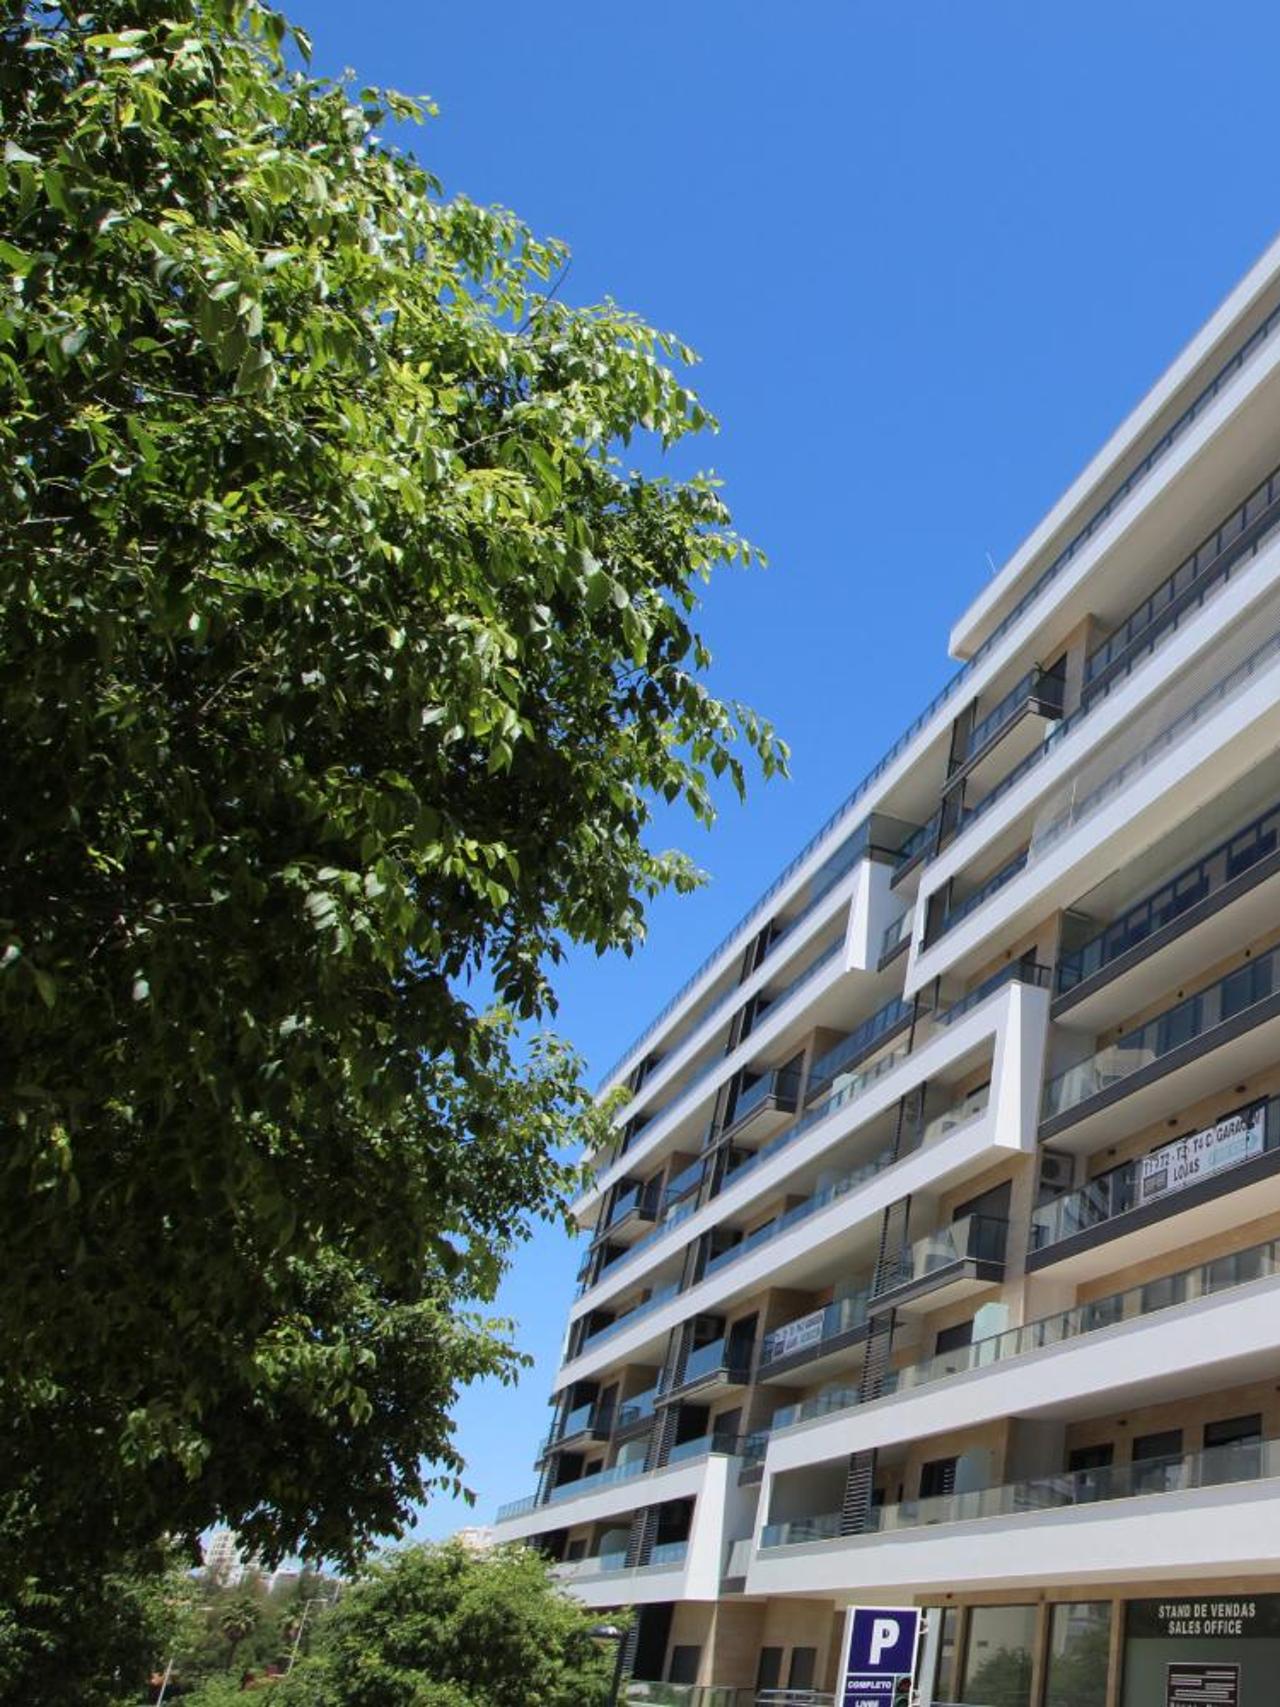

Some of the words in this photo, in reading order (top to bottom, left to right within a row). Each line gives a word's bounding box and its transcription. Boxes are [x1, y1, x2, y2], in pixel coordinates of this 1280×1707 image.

[1158, 1604, 1191, 1618] STAND
[1194, 1603, 1208, 1617] DE
[1211, 1602, 1256, 1617] VENDAS
[1168, 1620, 1201, 1634] SALES
[1204, 1620, 1243, 1634] OFFICE
[868, 1618, 900, 1665] P
[847, 1681, 892, 1689] COMPLETO
